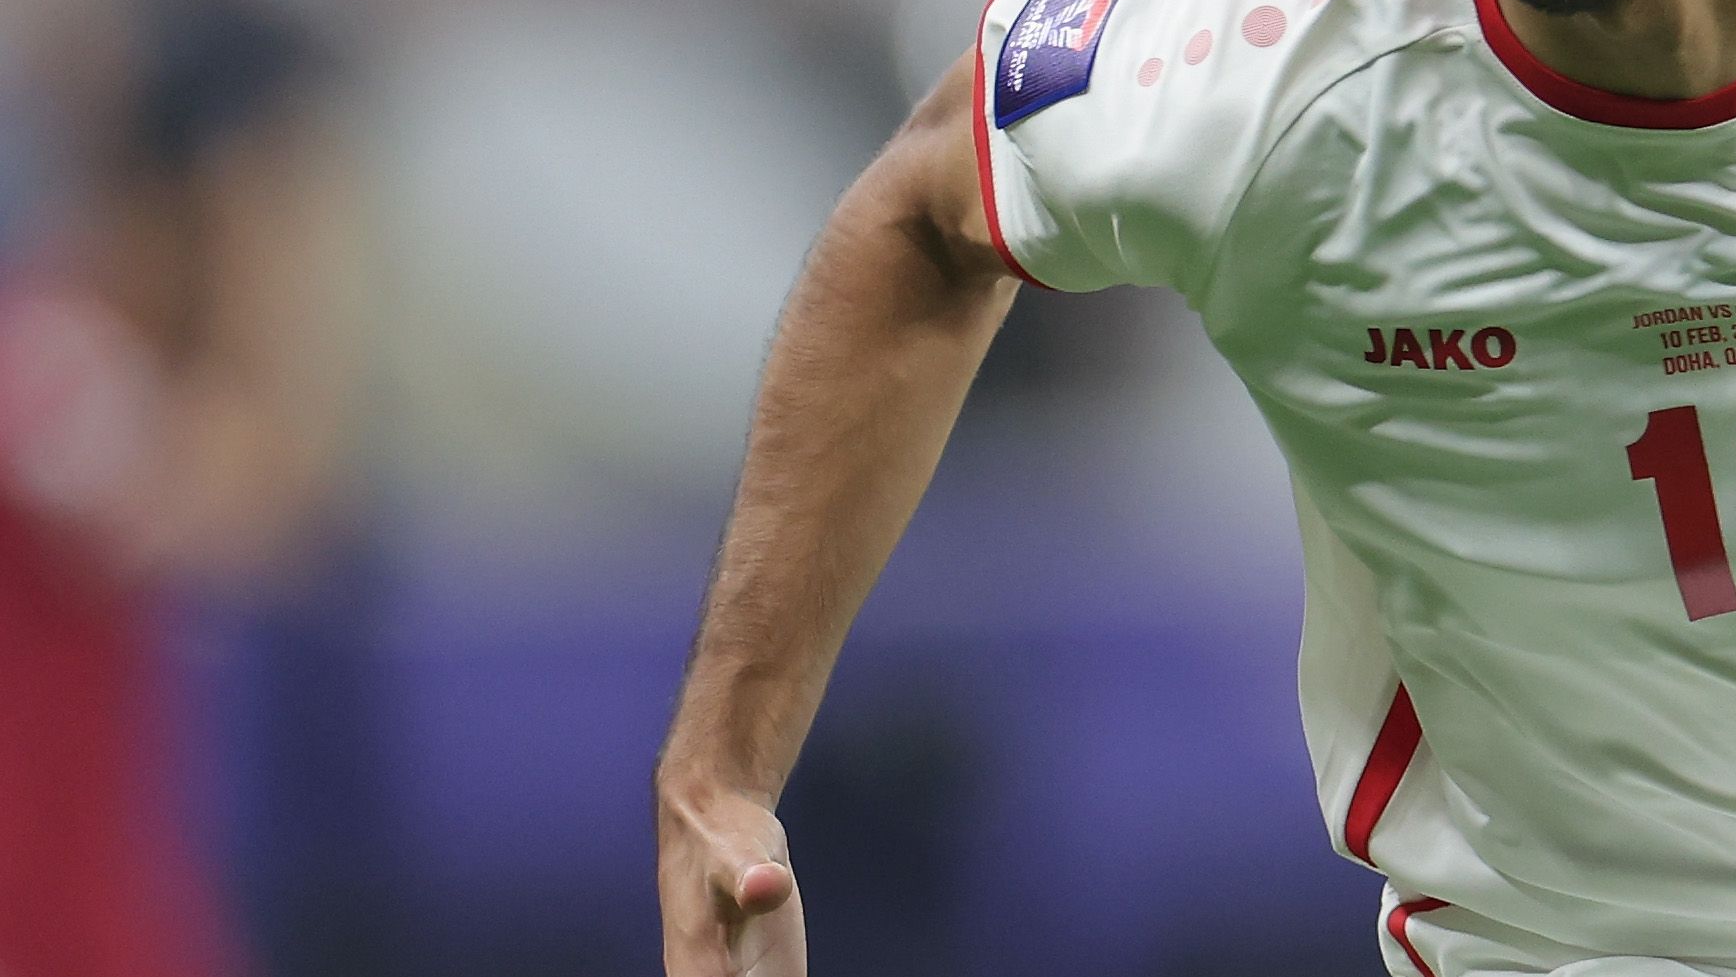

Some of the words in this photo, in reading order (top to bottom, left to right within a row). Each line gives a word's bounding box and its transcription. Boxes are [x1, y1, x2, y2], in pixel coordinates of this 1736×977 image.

[1633, 306, 1703, 329] JORDAN
[1708, 304, 1732, 319] VS
[1364, 327, 1516, 370] JAKO
[1661, 330, 1682, 349] 10
